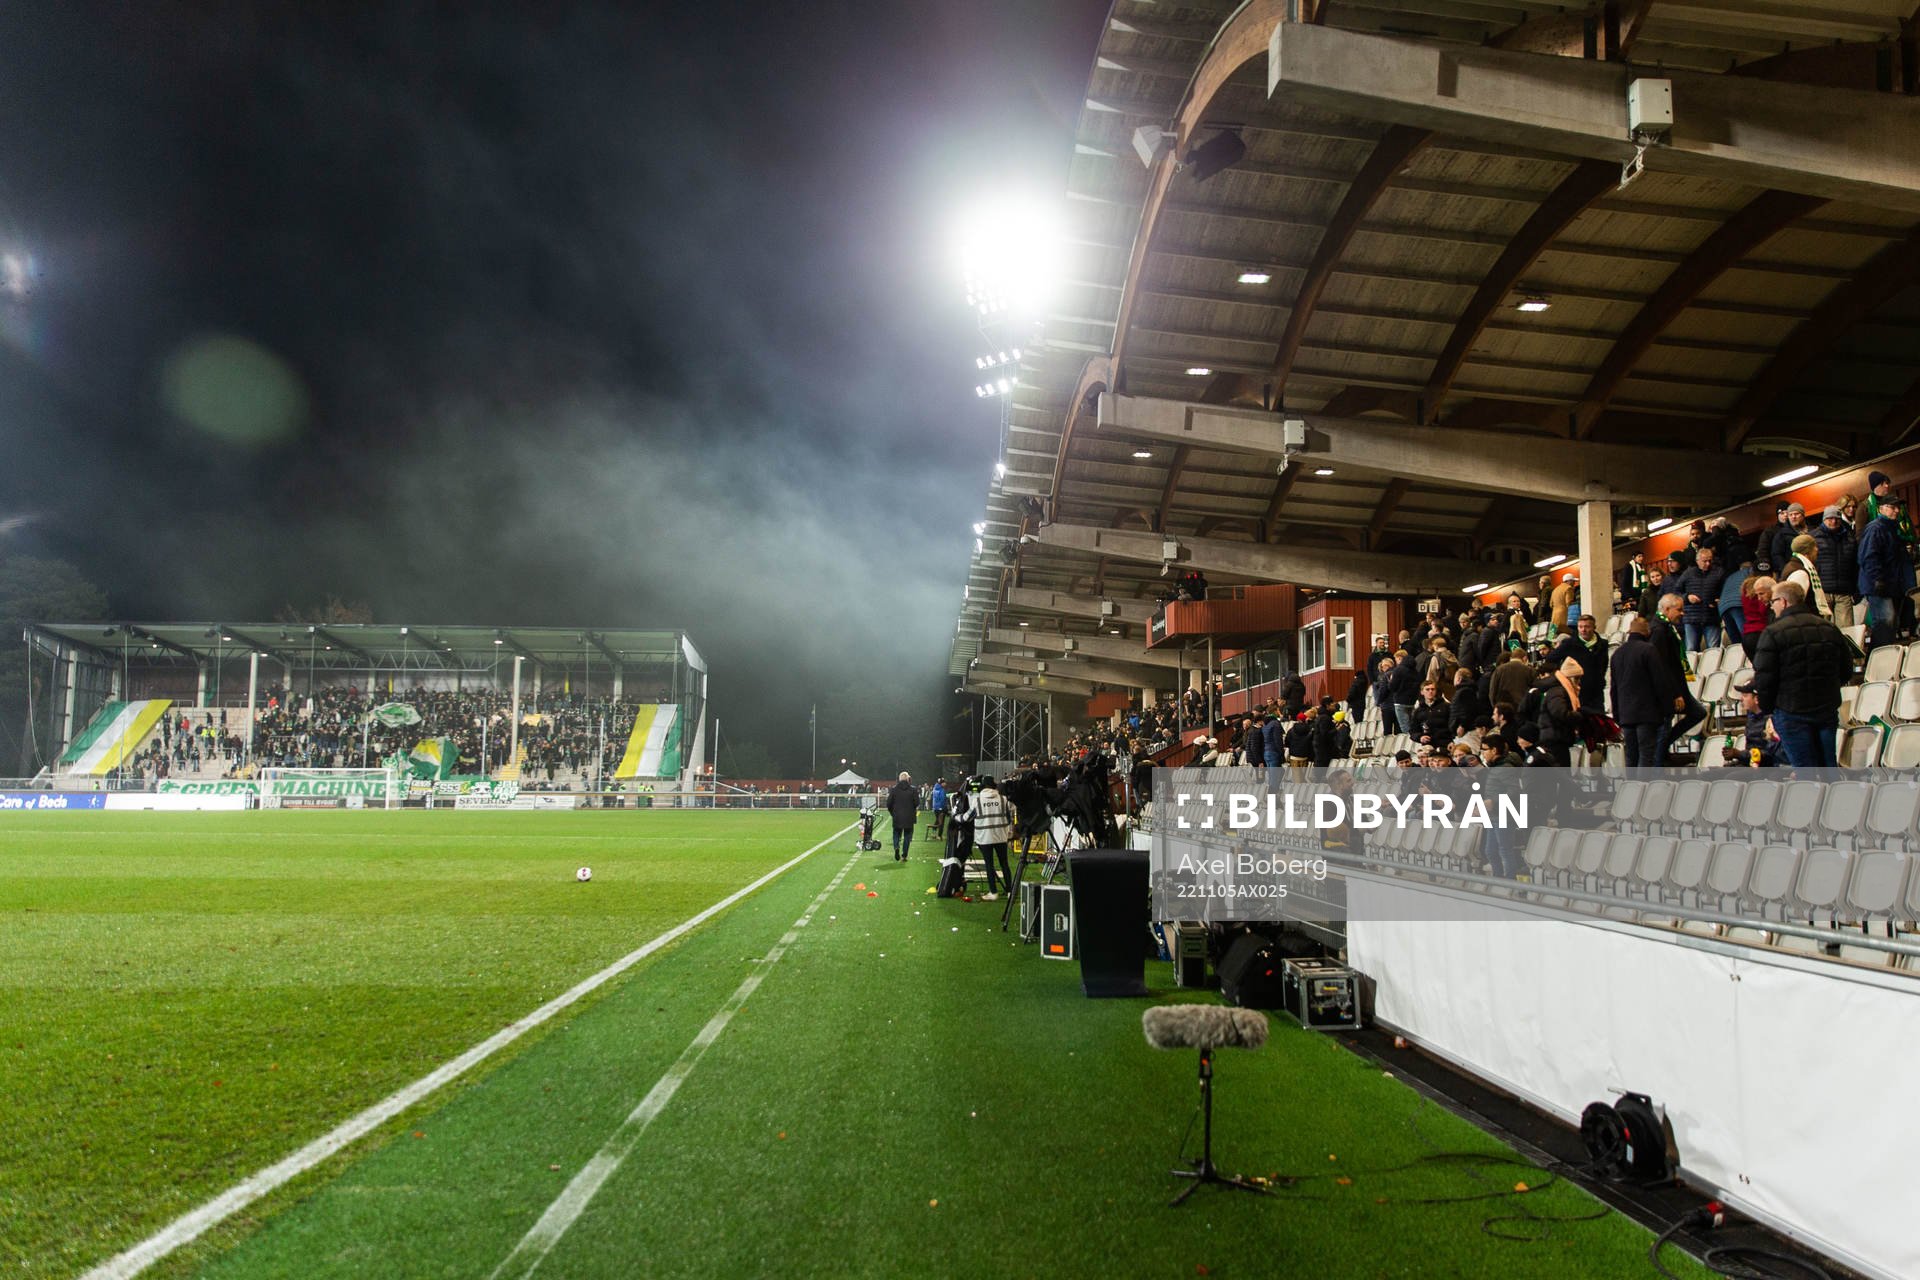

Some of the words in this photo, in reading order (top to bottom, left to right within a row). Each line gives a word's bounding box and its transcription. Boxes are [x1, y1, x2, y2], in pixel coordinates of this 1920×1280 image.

[272, 781, 387, 797] MACHINE
[0, 794, 23, 808] Care
[38, 794, 68, 808] Beds
